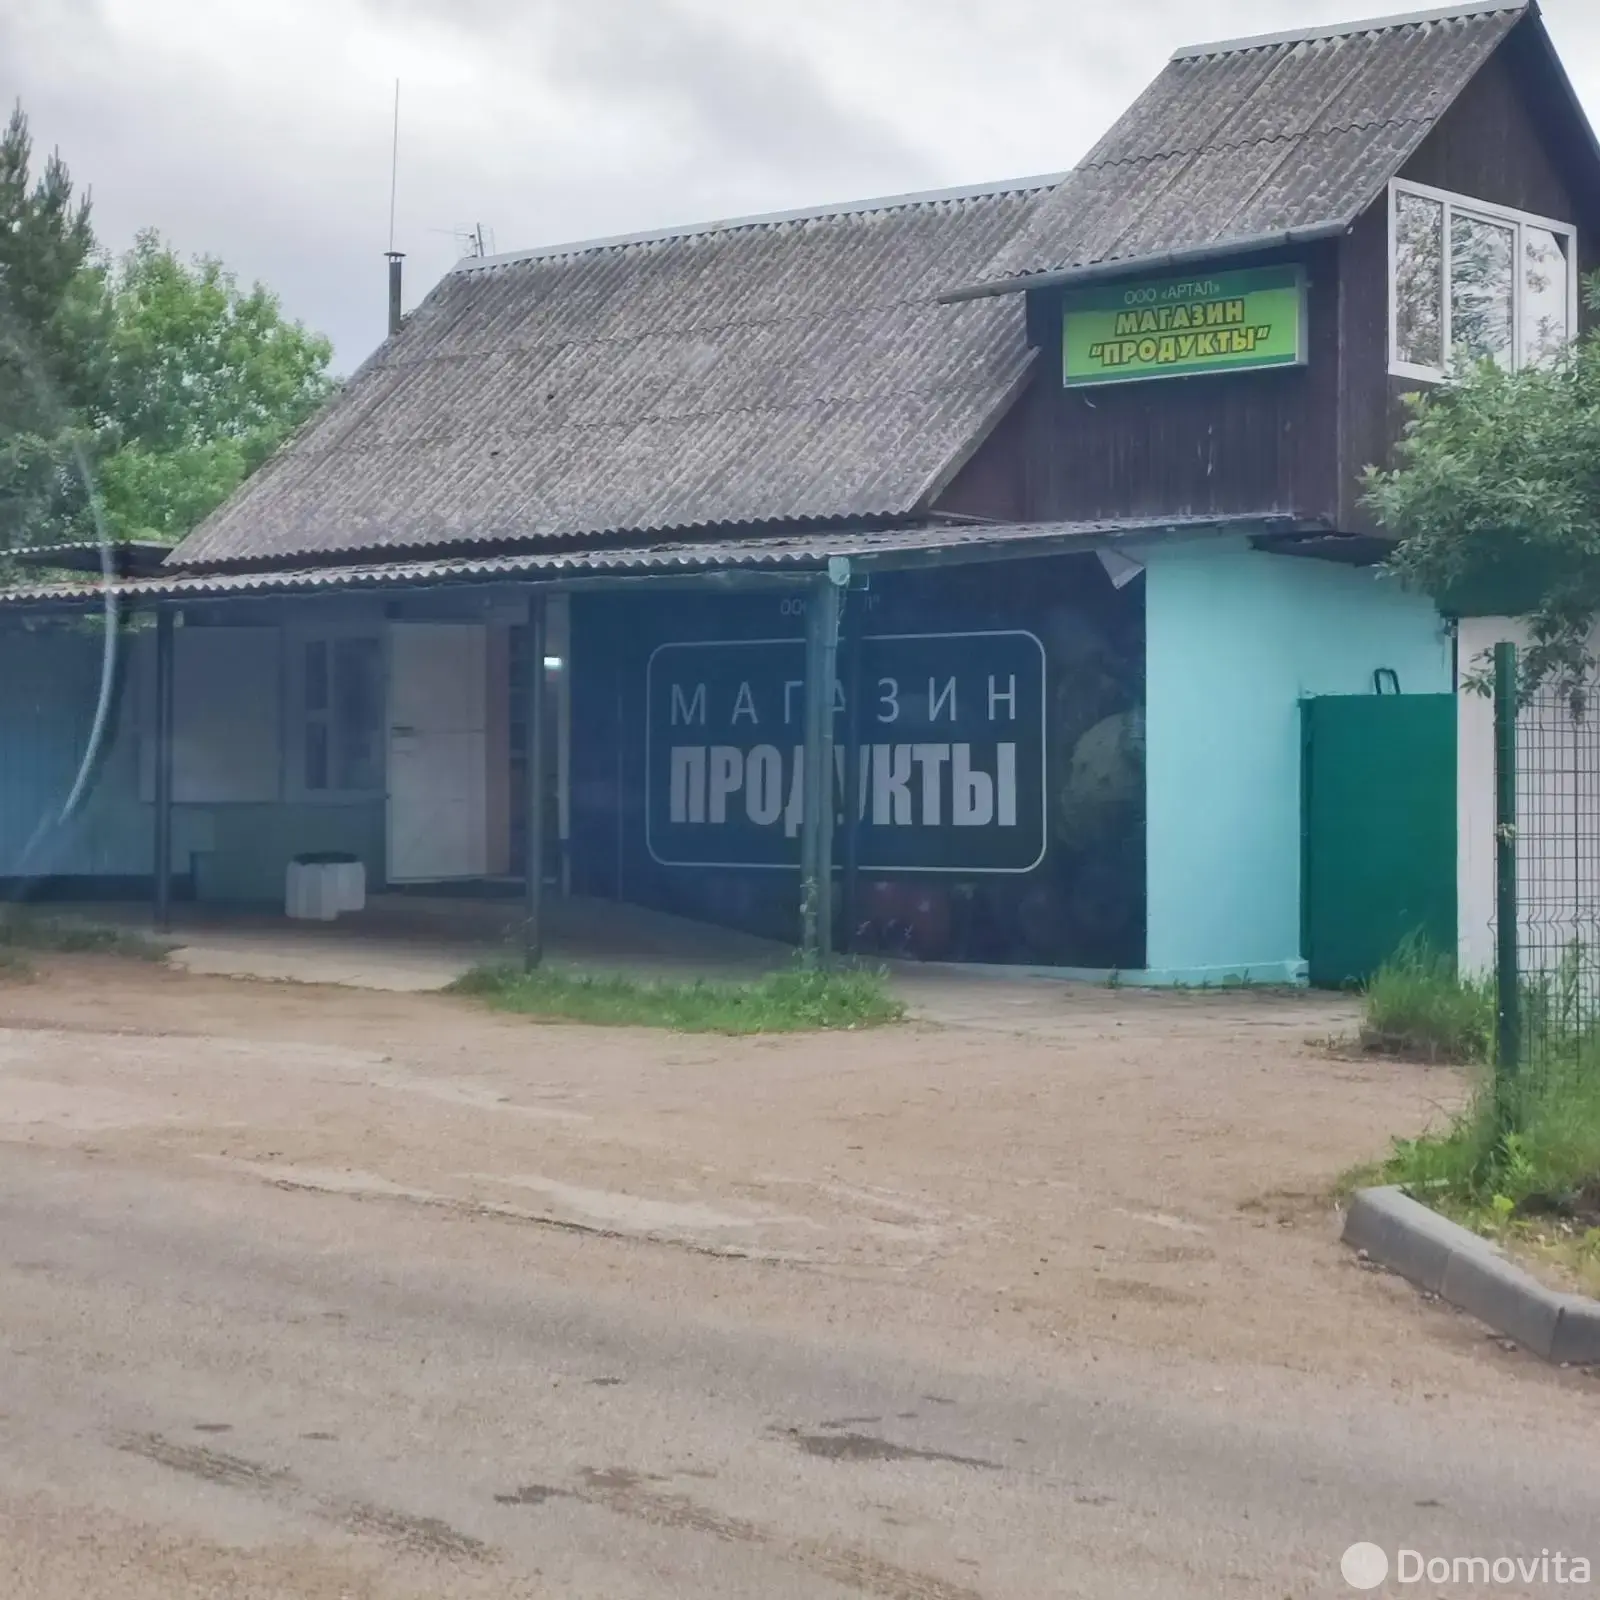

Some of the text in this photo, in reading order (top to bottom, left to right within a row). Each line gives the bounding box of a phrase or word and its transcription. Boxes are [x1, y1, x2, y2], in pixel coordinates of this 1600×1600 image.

[1124, 280, 1220, 304] ООО «АРТАЛ»
[1115, 298, 1244, 336] МАГАЗИН
[780, 599, 807, 615] ОО
